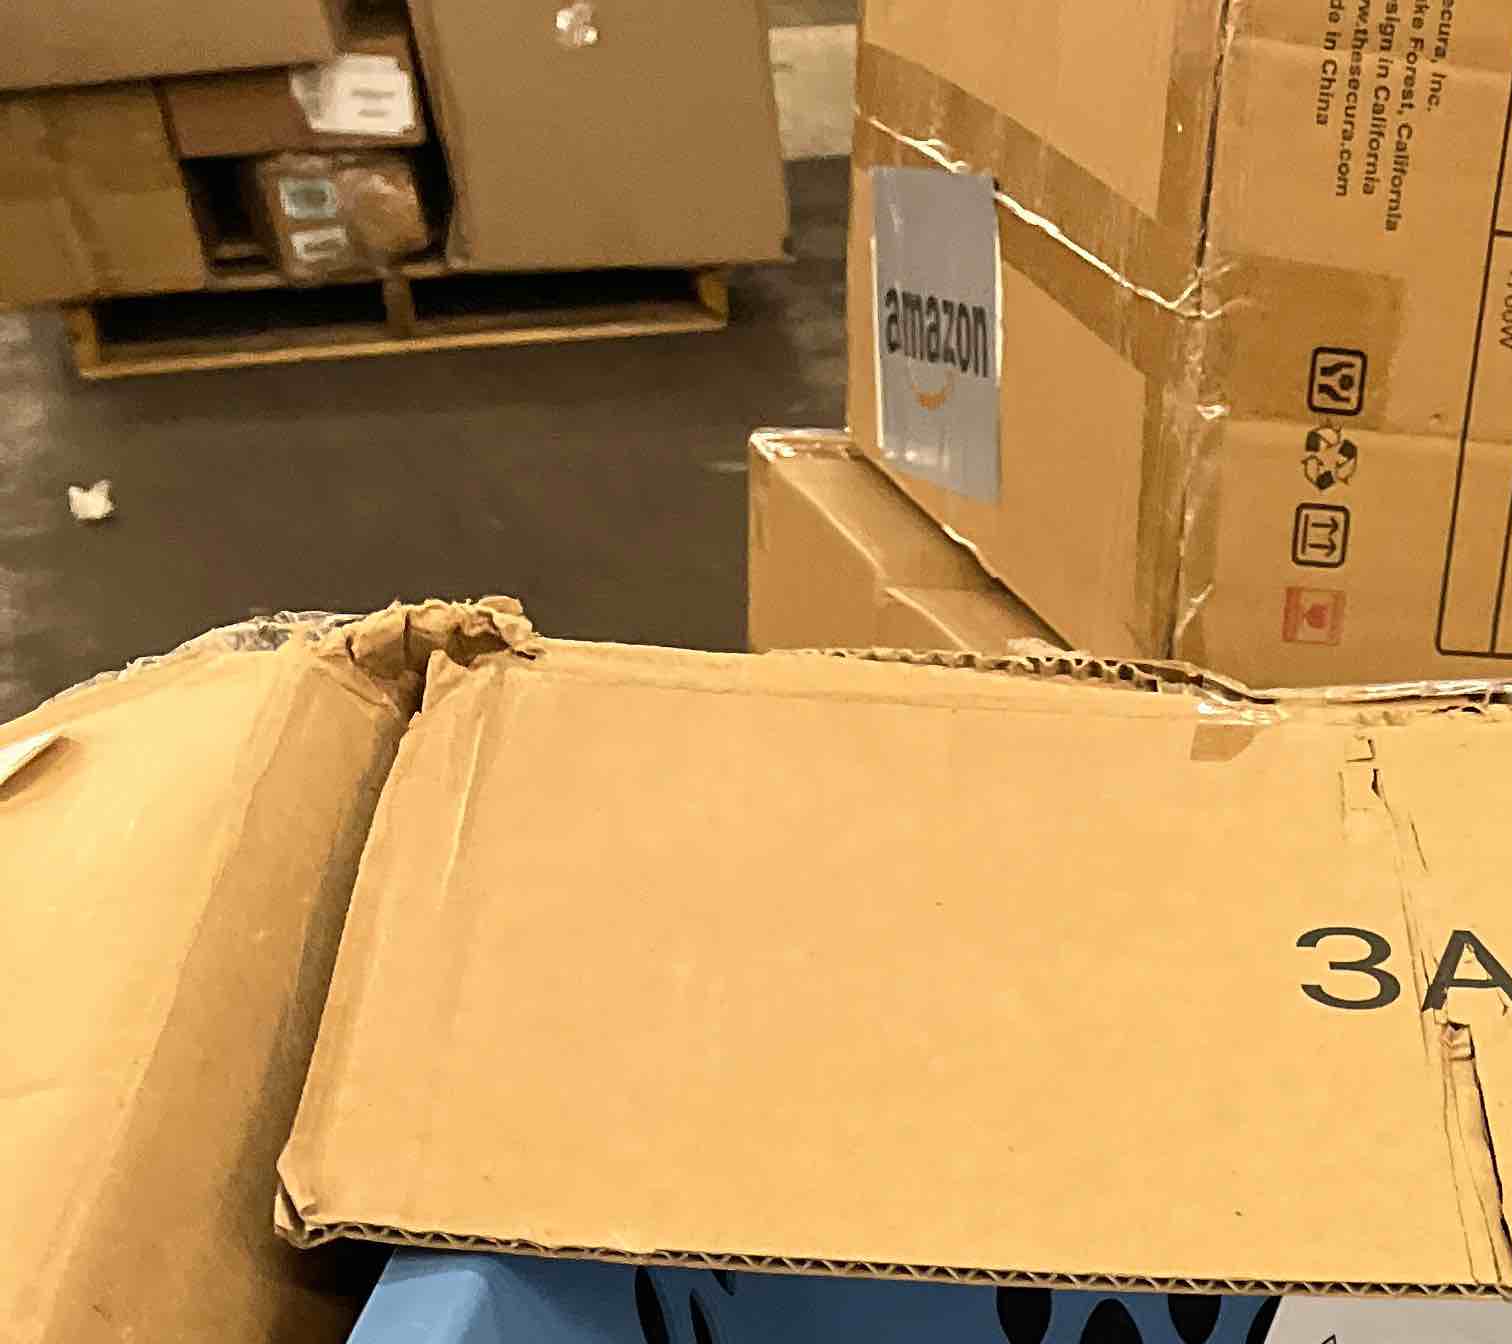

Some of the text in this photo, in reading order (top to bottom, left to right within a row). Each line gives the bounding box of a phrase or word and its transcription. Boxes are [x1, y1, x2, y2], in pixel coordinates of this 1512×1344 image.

[1323, 31, 1341, 51] in
[1376, 57, 1394, 79] in
[1396, 36, 1425, 115] Forest,
[1316, 58, 1338, 125] China
[1427, 71, 1448, 112] Inc.
[1362, 84, 1391, 195] California
[1384, 122, 1413, 232] California
[885, 287, 990, 379] amazon
